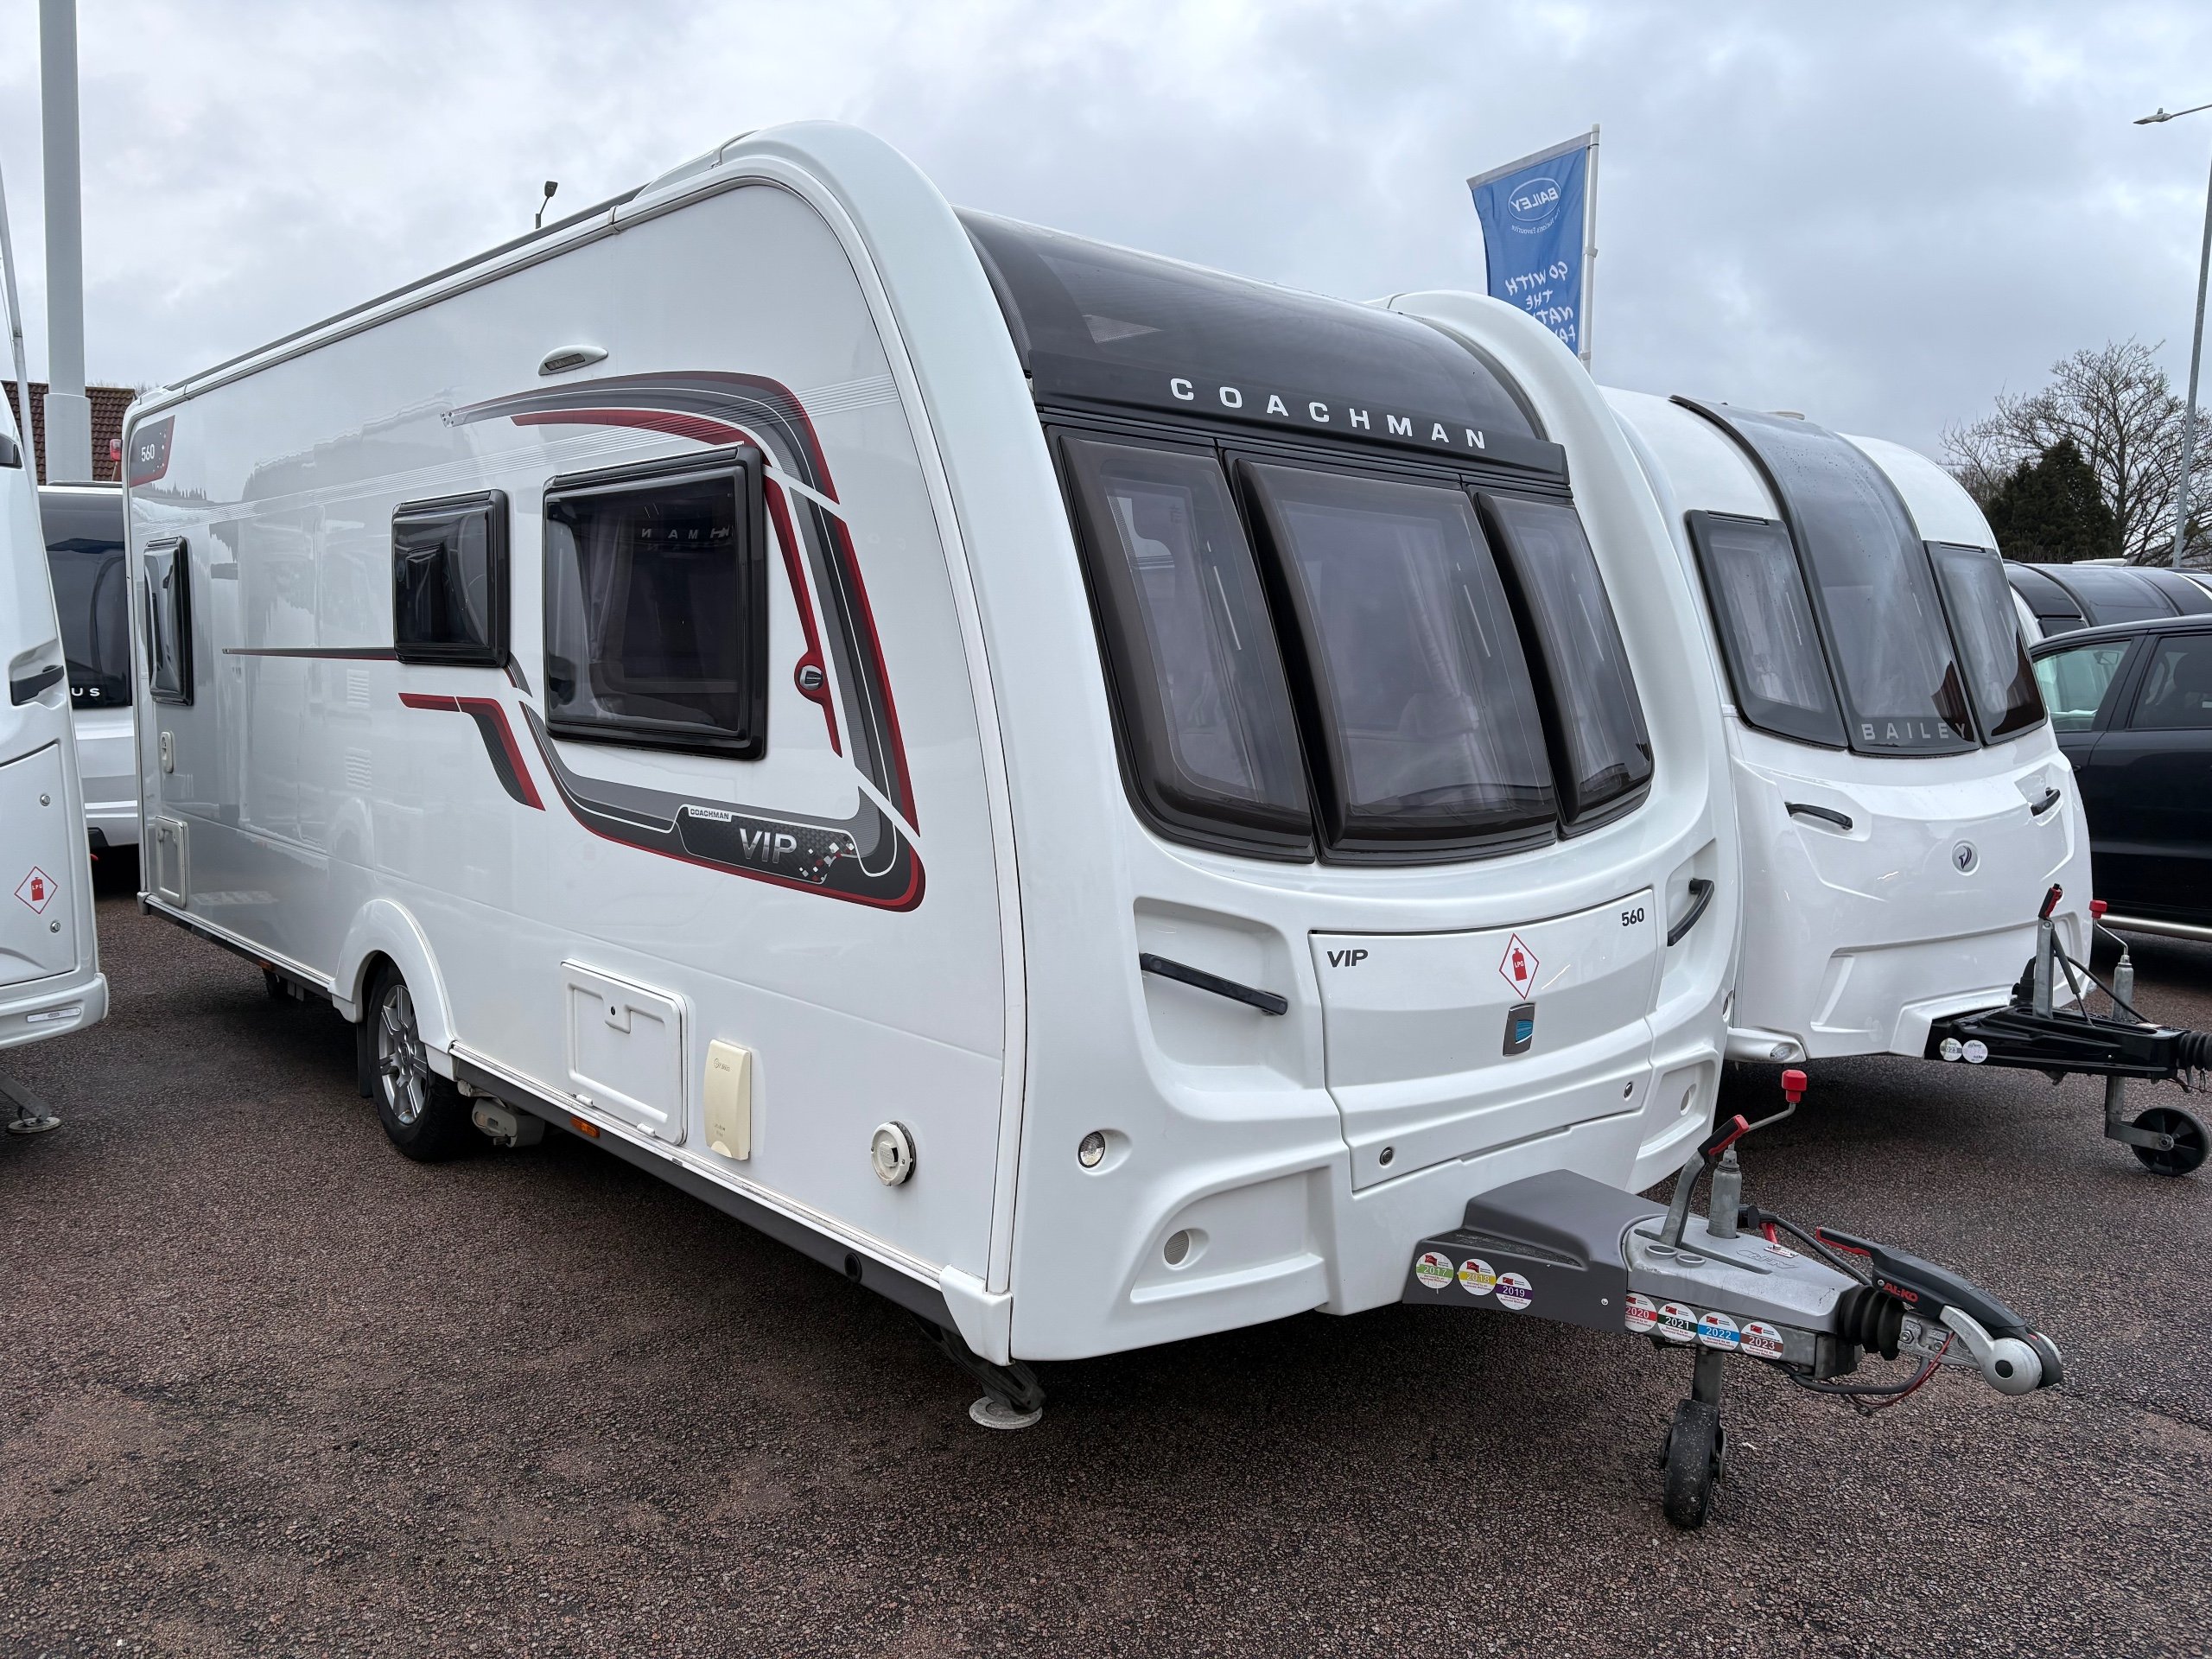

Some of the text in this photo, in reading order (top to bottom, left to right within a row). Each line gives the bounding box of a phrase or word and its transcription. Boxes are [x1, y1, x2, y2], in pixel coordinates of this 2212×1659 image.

[1170, 378, 1485, 449] COACHMAN
[141, 443, 156, 462] 560
[1861, 722, 1966, 741] BAILEY
[690, 808, 730, 820] COACHMAN
[739, 827, 798, 864] VIP
[1621, 907, 1645, 927] 560
[1326, 949, 1369, 968] VIP
[1423, 1266, 1447, 1276] 2017
[1466, 1272, 1490, 1284] 2018
[1503, 1286, 1525, 1297] 2019
[1883, 1282, 1919, 1303] AL-KO
[1625, 1306, 1649, 1319] 2020
[1665, 1316, 1689, 1330] 2021
[1706, 1326, 1732, 1340] 2022
[1748, 1336, 1775, 1351] 2023
